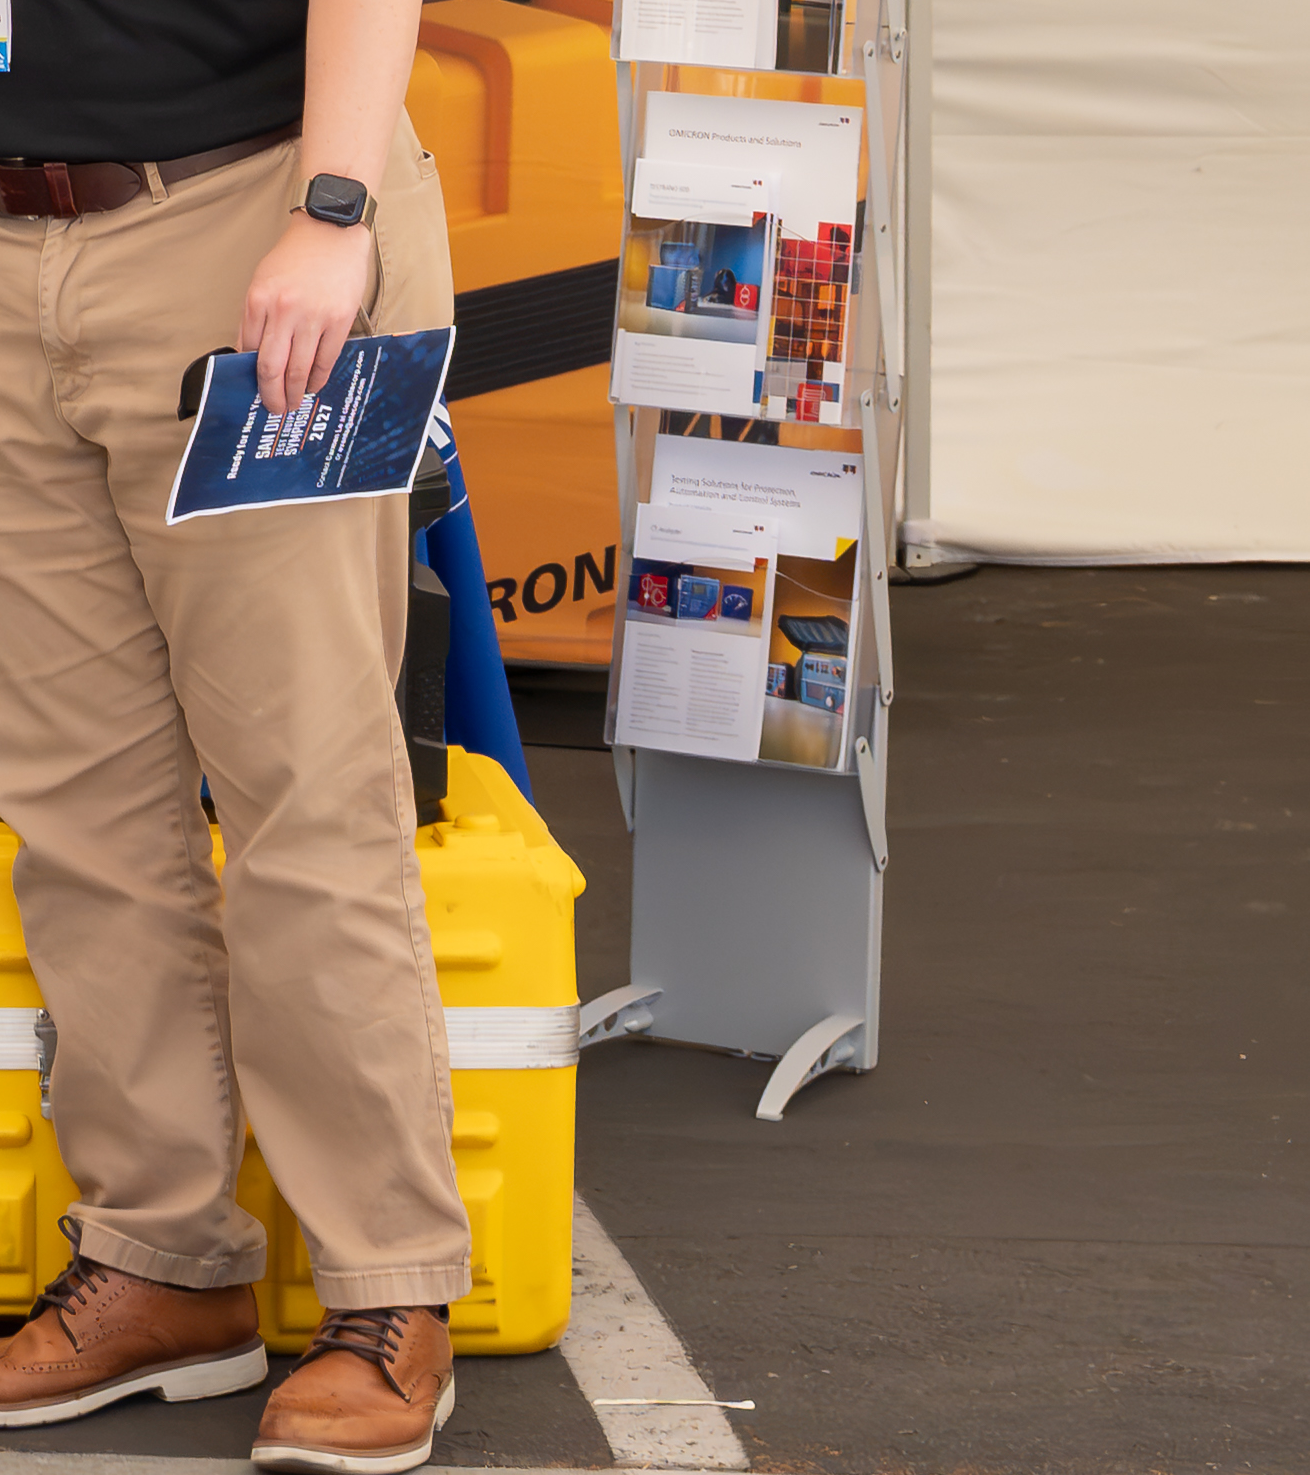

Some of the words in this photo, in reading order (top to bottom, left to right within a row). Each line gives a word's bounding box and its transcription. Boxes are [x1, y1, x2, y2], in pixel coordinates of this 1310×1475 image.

[669, 129, 710, 140] OMICRON
[712, 132, 746, 143] Products
[748, 136, 764, 144] and
[766, 137, 801, 148] Solutions
[241, 413, 256, 433] Next
[284, 393, 316, 457] SYMPOSIUM
[308, 405, 332, 441] 2027
[236, 433, 249, 449] for
[255, 433, 273, 459] SAN
[275, 437, 286, 457] TEST
[227, 449, 246, 480] Ready
